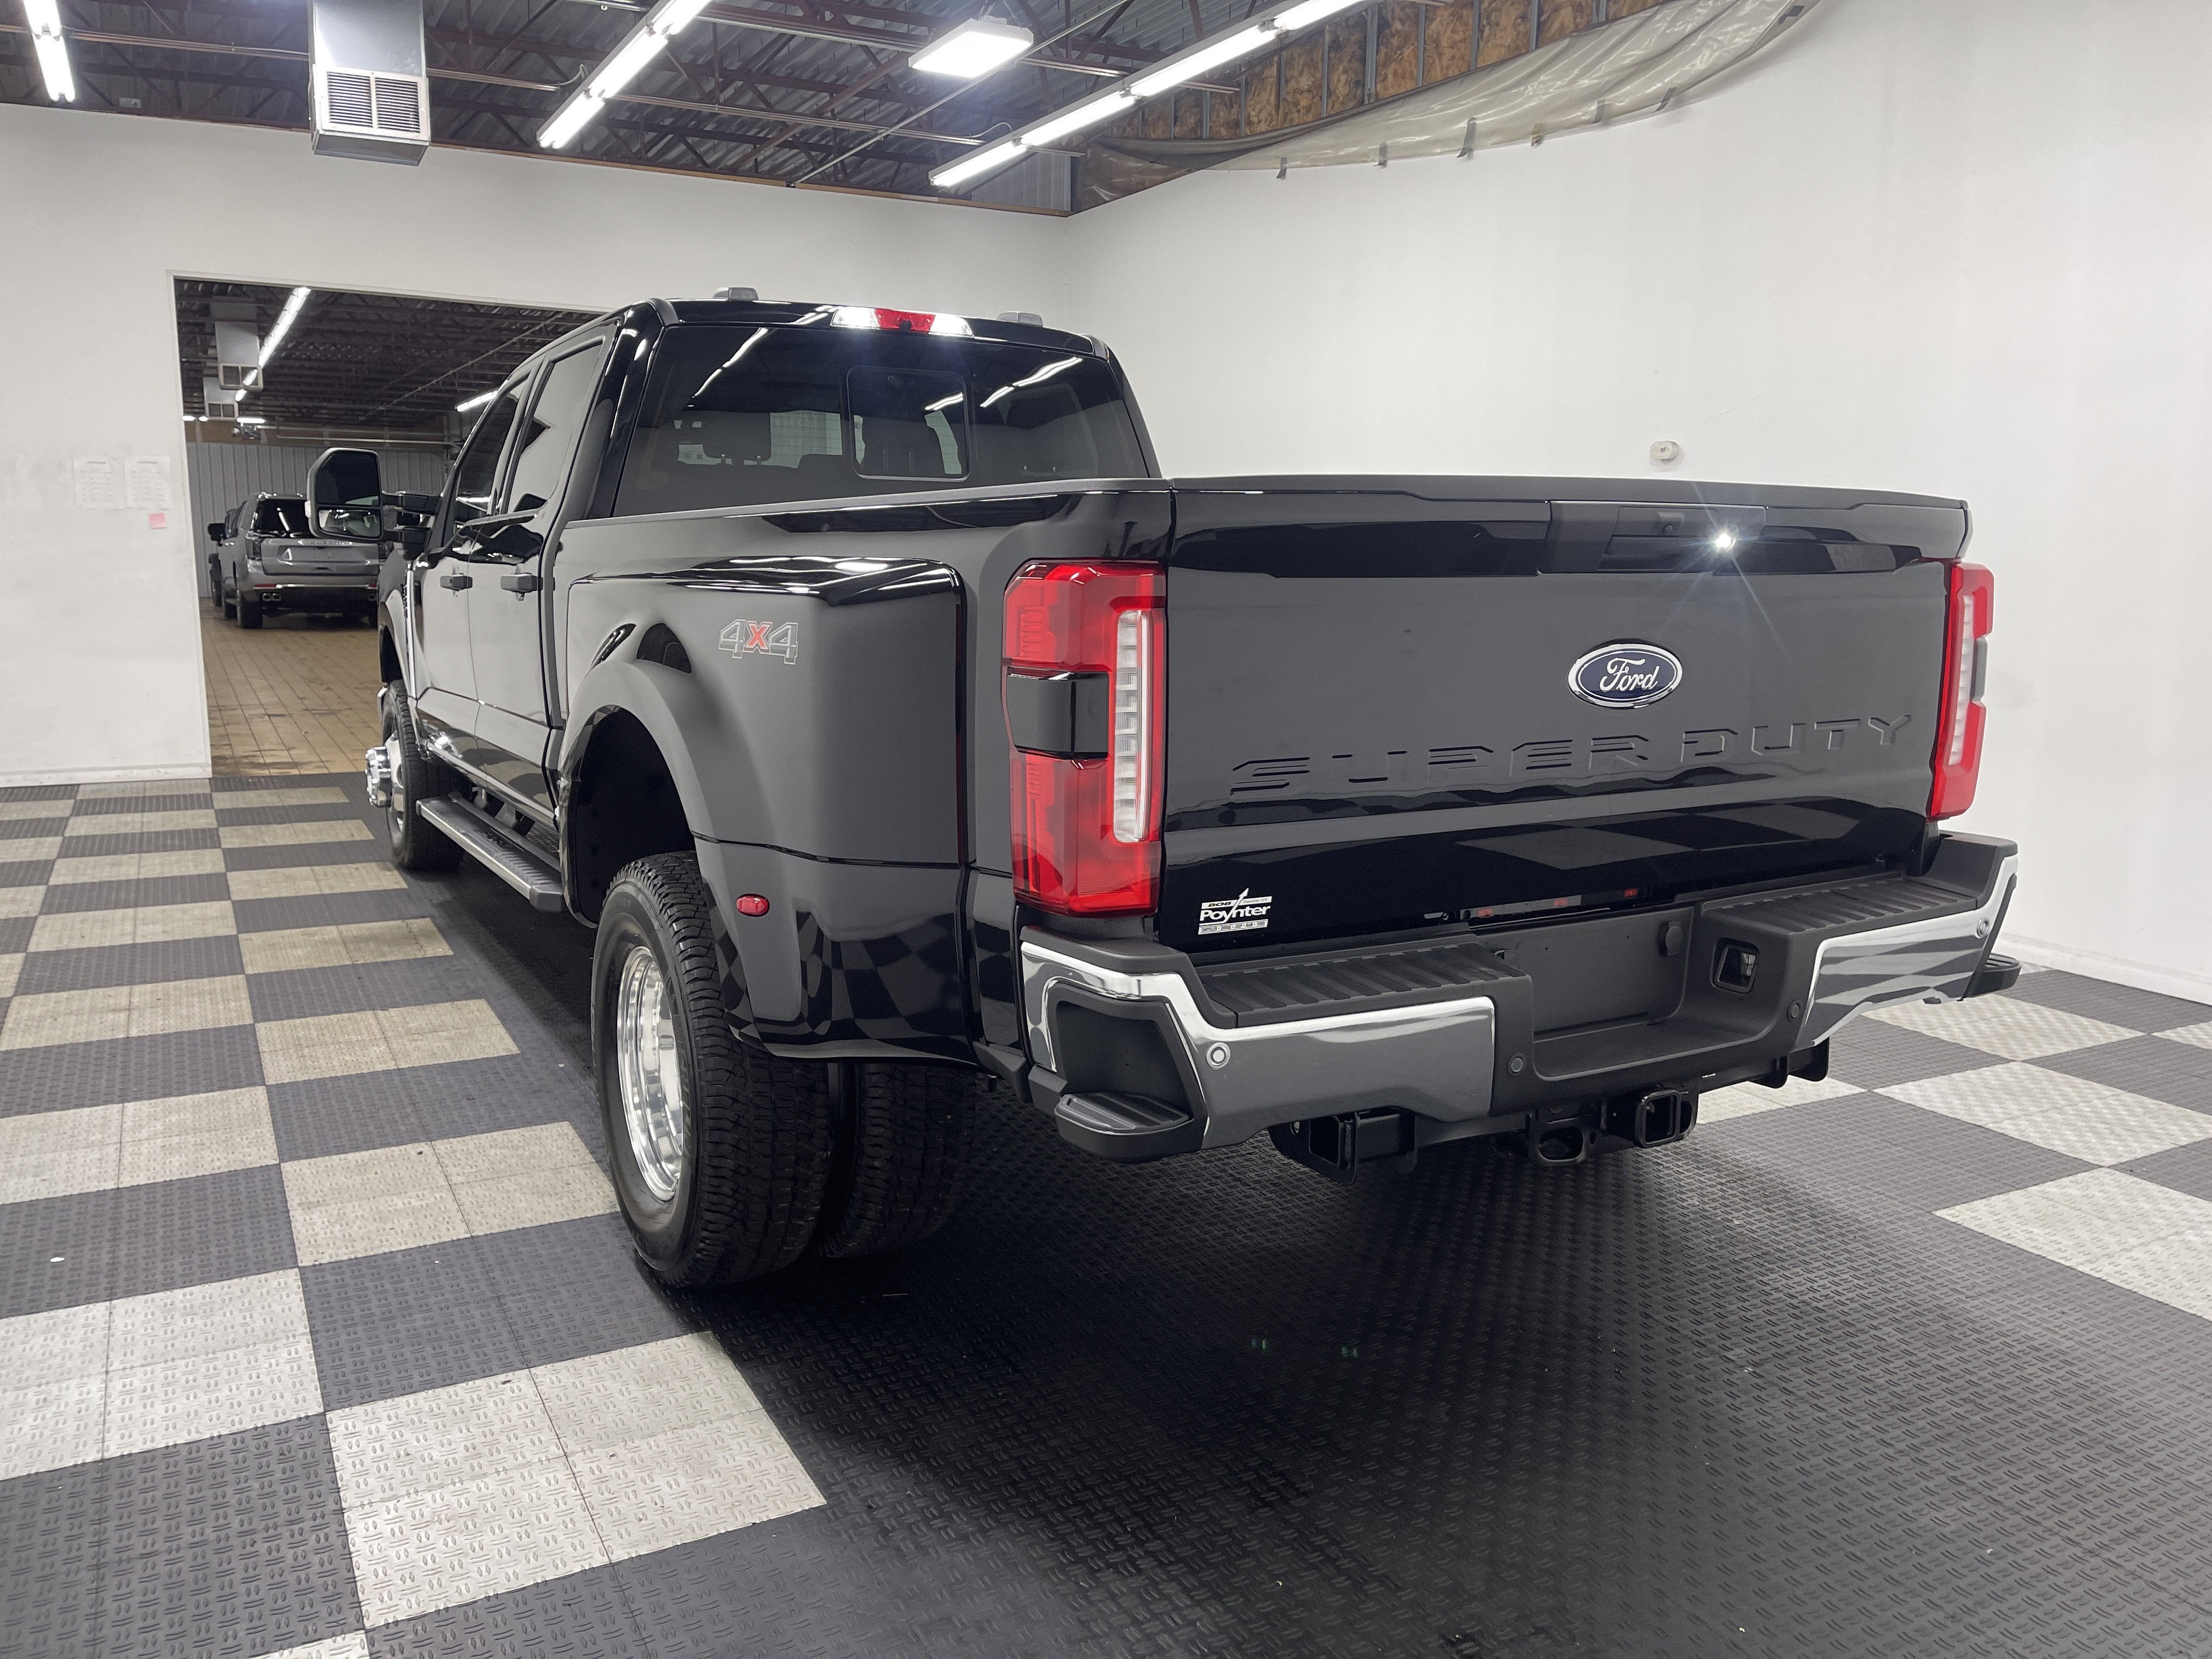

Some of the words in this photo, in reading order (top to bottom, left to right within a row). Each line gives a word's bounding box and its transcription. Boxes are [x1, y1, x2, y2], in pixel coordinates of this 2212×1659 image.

[1599, 657, 1660, 692] Ford
[1230, 735, 1649, 797] SUPER
[1680, 714, 1912, 763] DUTY
[1199, 905, 1271, 922] Poynter
